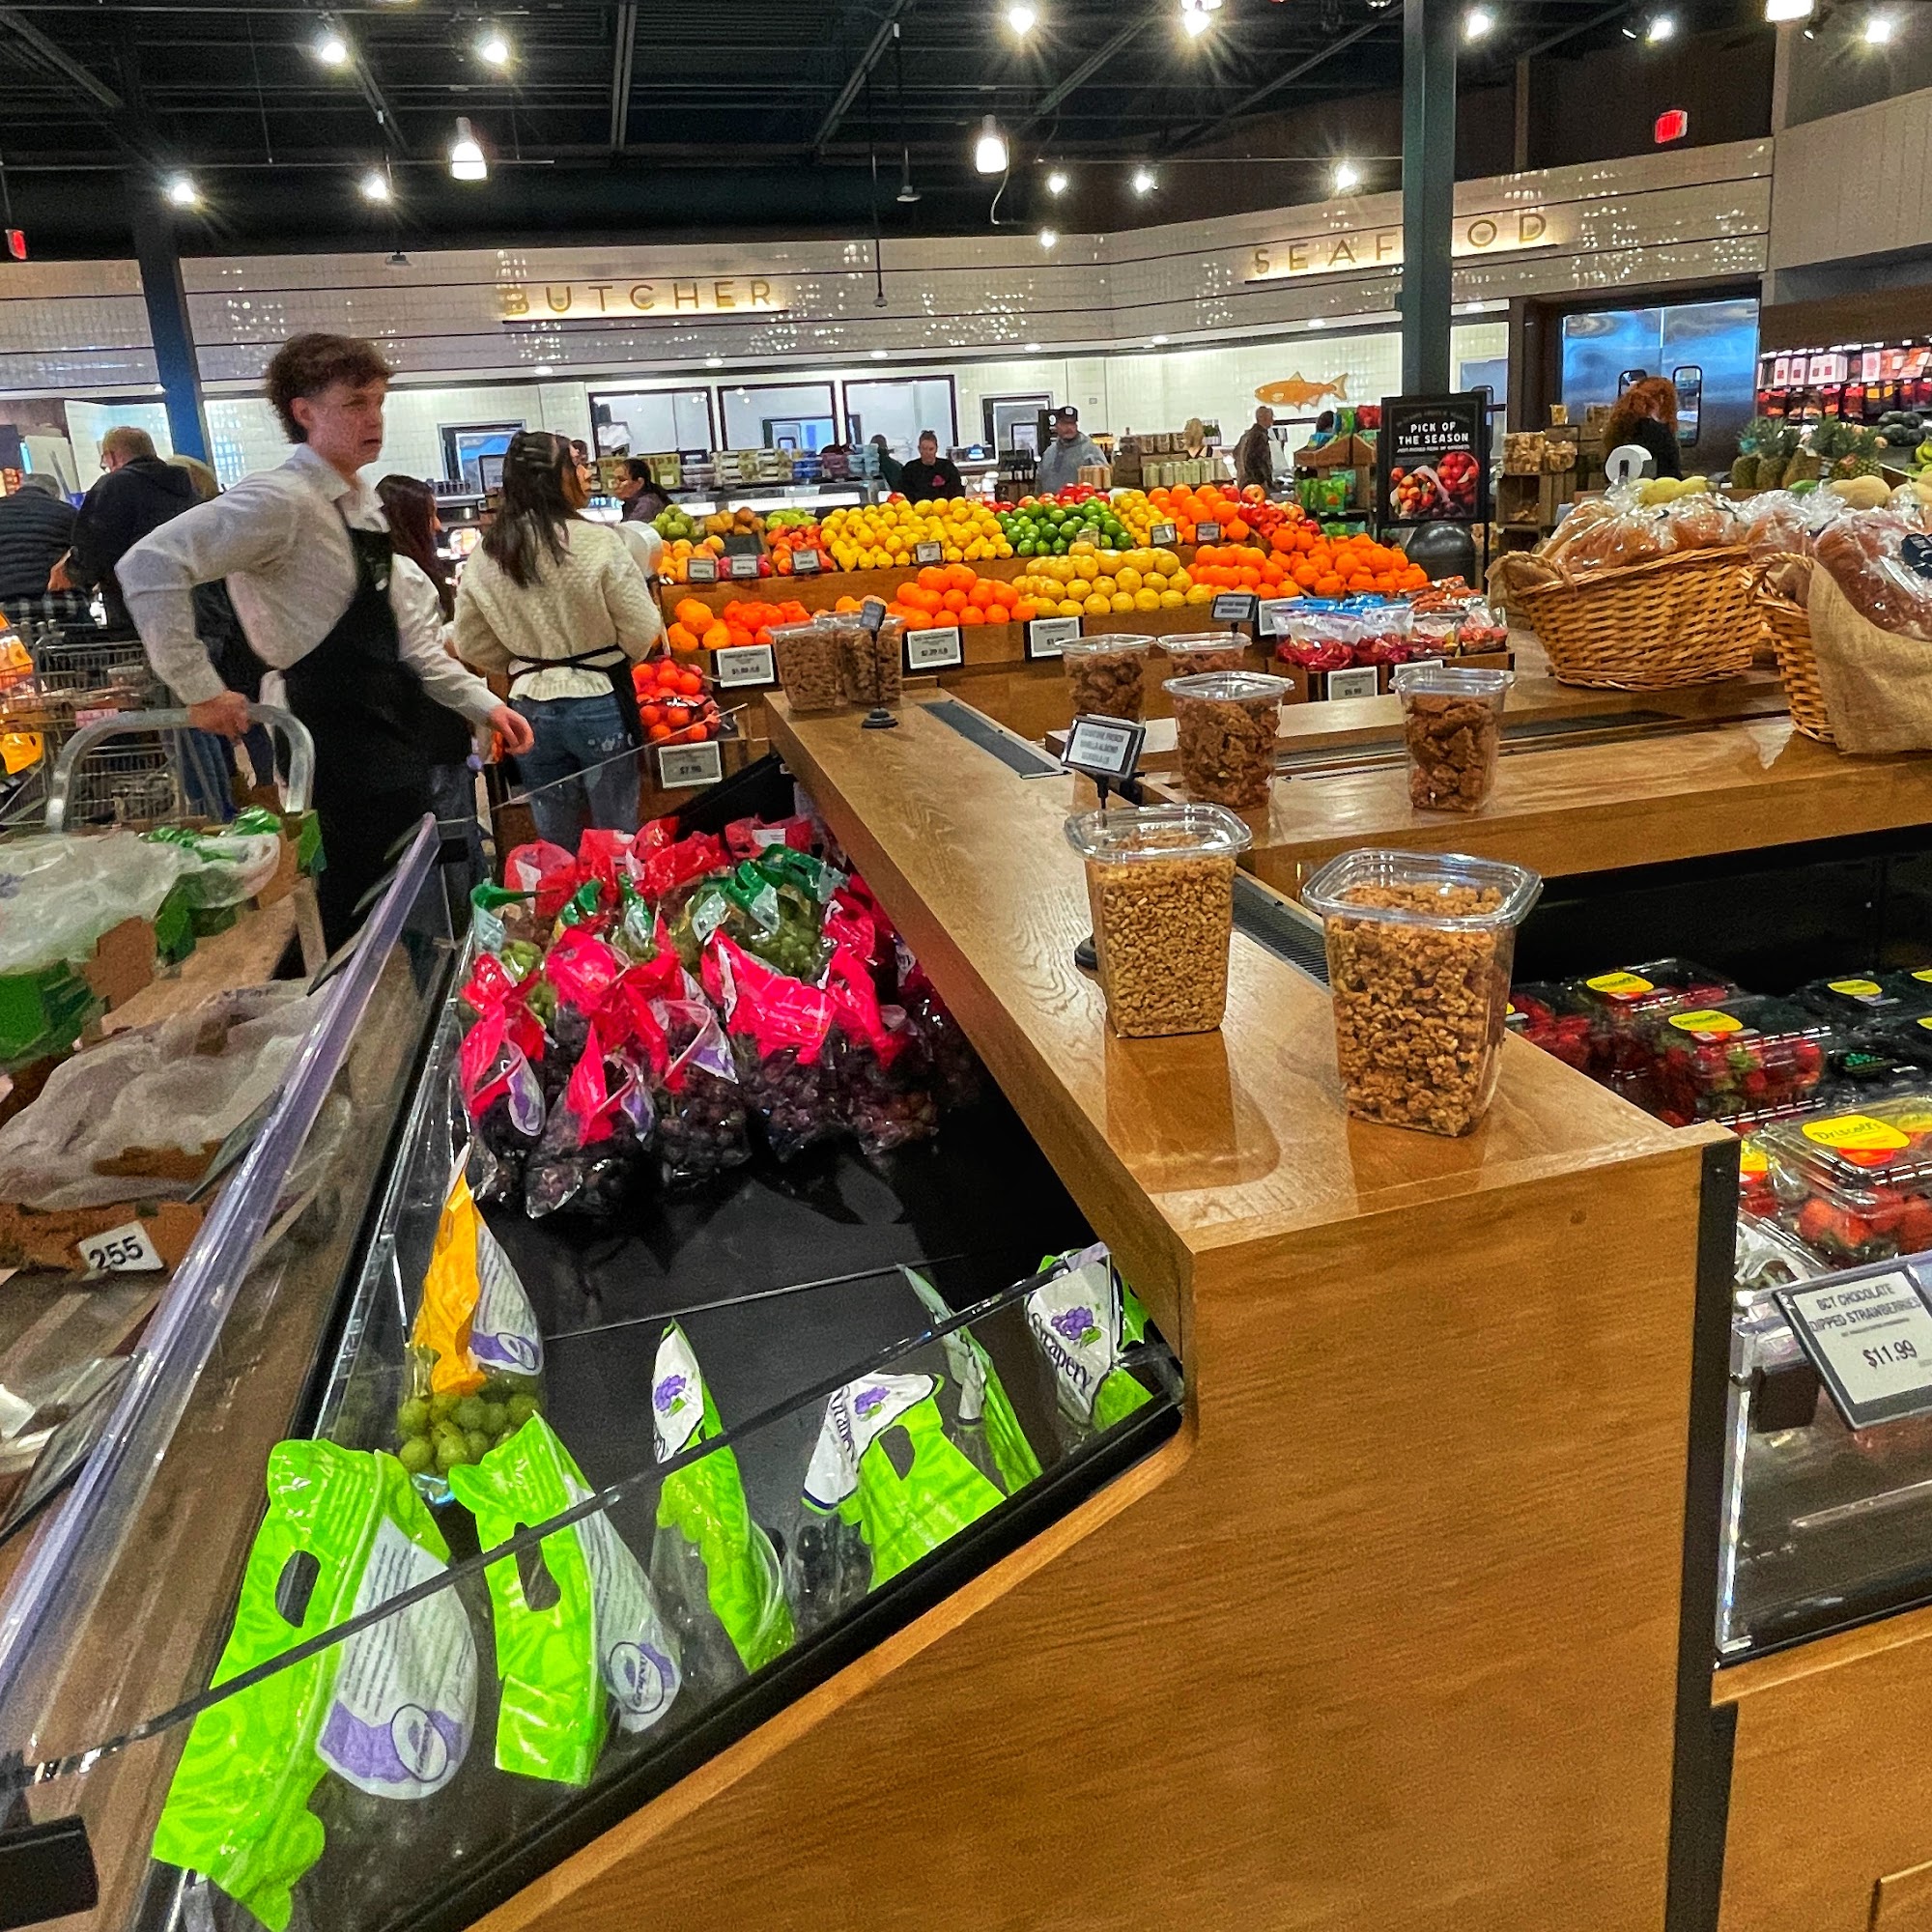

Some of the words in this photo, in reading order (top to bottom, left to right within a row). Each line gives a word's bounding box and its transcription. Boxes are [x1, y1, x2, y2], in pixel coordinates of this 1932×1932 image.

[1255, 213, 1547, 274] SEAFOD
[502, 279, 771, 316] BUTCHER
[1398, 435, 1420, 445] THE
[1424, 432, 1469, 444] SEASON
[1410, 423, 1436, 434] PICK
[1441, 421, 1457, 432] OF
[89, 1235, 144, 1271] 255
[1837, 1282, 1895, 1306] CHOCOLATE
[1845, 1295, 1922, 1323] STRAWBERRIES
[1862, 1339, 1918, 1370] $11.99
